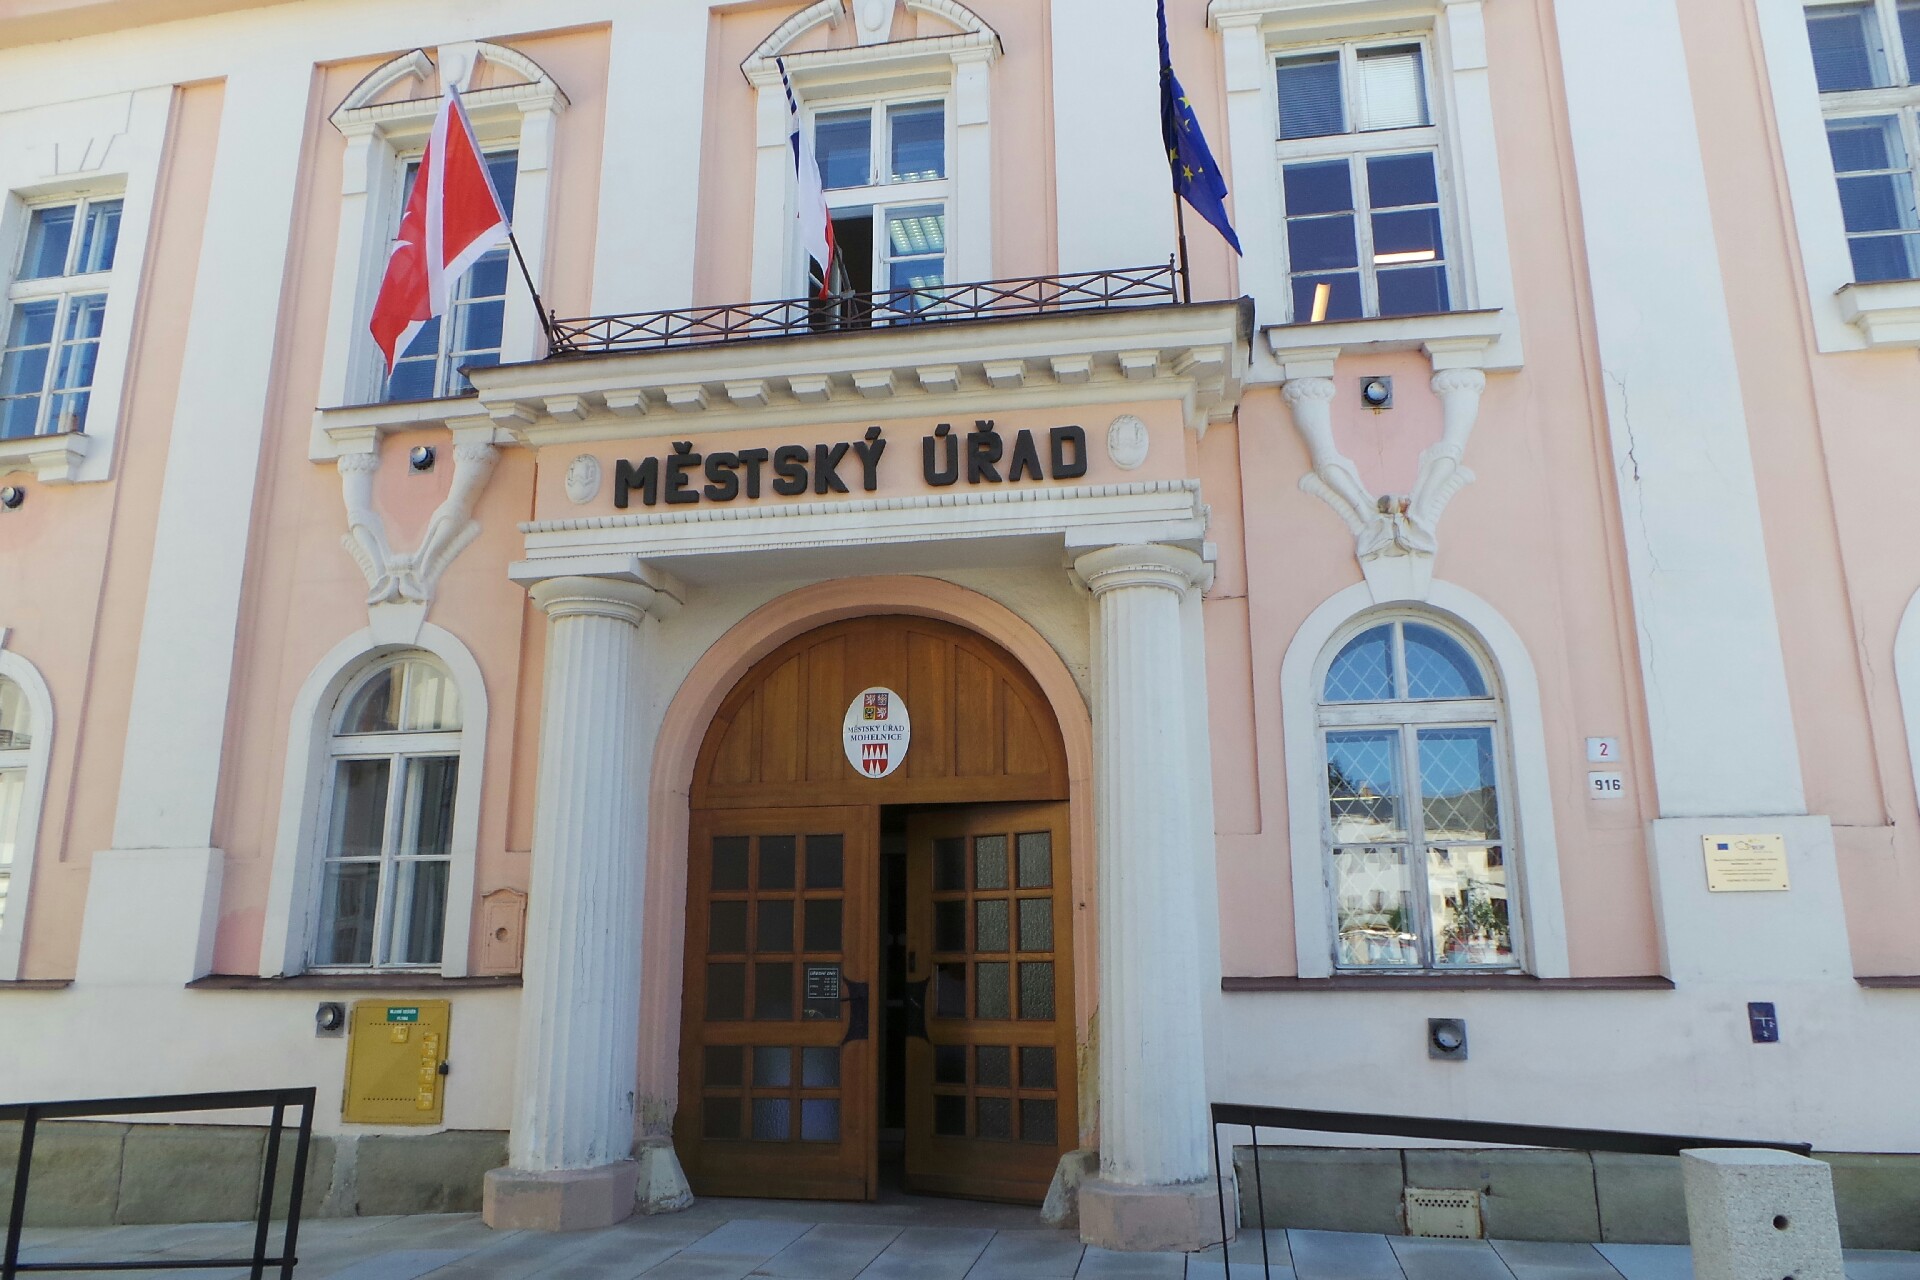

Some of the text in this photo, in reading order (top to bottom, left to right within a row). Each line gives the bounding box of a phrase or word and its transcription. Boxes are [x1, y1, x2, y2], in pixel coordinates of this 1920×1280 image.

[614, 420, 1087, 508] MĚSTSKÝ ÚŘAD
[882, 723, 905, 732] ÚŘAD
[850, 733, 902, 741] MOHELNICE
[1600, 742, 1608, 756] 2
[1594, 779, 1620, 791] 916
